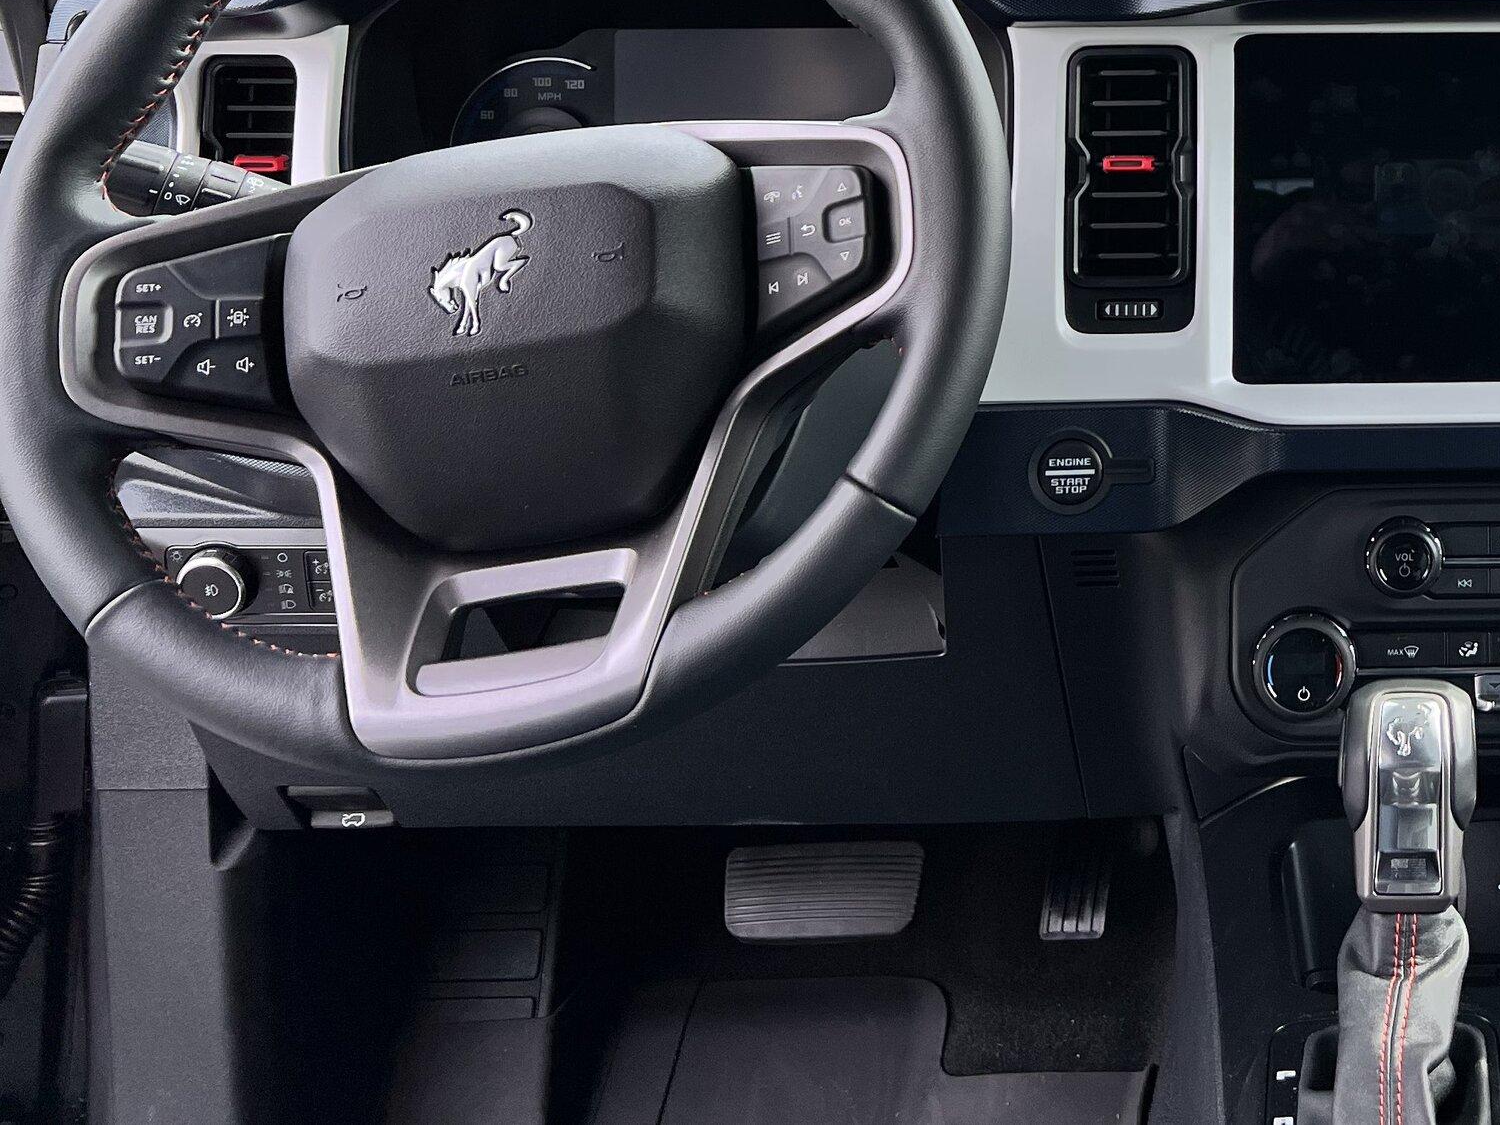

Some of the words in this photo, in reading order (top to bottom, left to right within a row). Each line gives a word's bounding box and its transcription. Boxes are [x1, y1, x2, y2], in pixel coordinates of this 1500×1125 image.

[532, 77, 551, 87] 100
[565, 79, 584, 90] 120
[504, 88, 518, 98] 80
[537, 92, 562, 101] MPH
[480, 110, 495, 120] 60
[839, 217, 852, 226] OK
[135, 283, 162, 293] SET+
[134, 315, 157, 324] CAN
[135, 325, 155, 334] RES
[449, 363, 526, 386] AIRBAG
[1048, 458, 1092, 467] ENGINE
[1051, 477, 1090, 487] START
[1055, 485, 1087, 494] STOP
[1394, 553, 1414, 562] VOL
